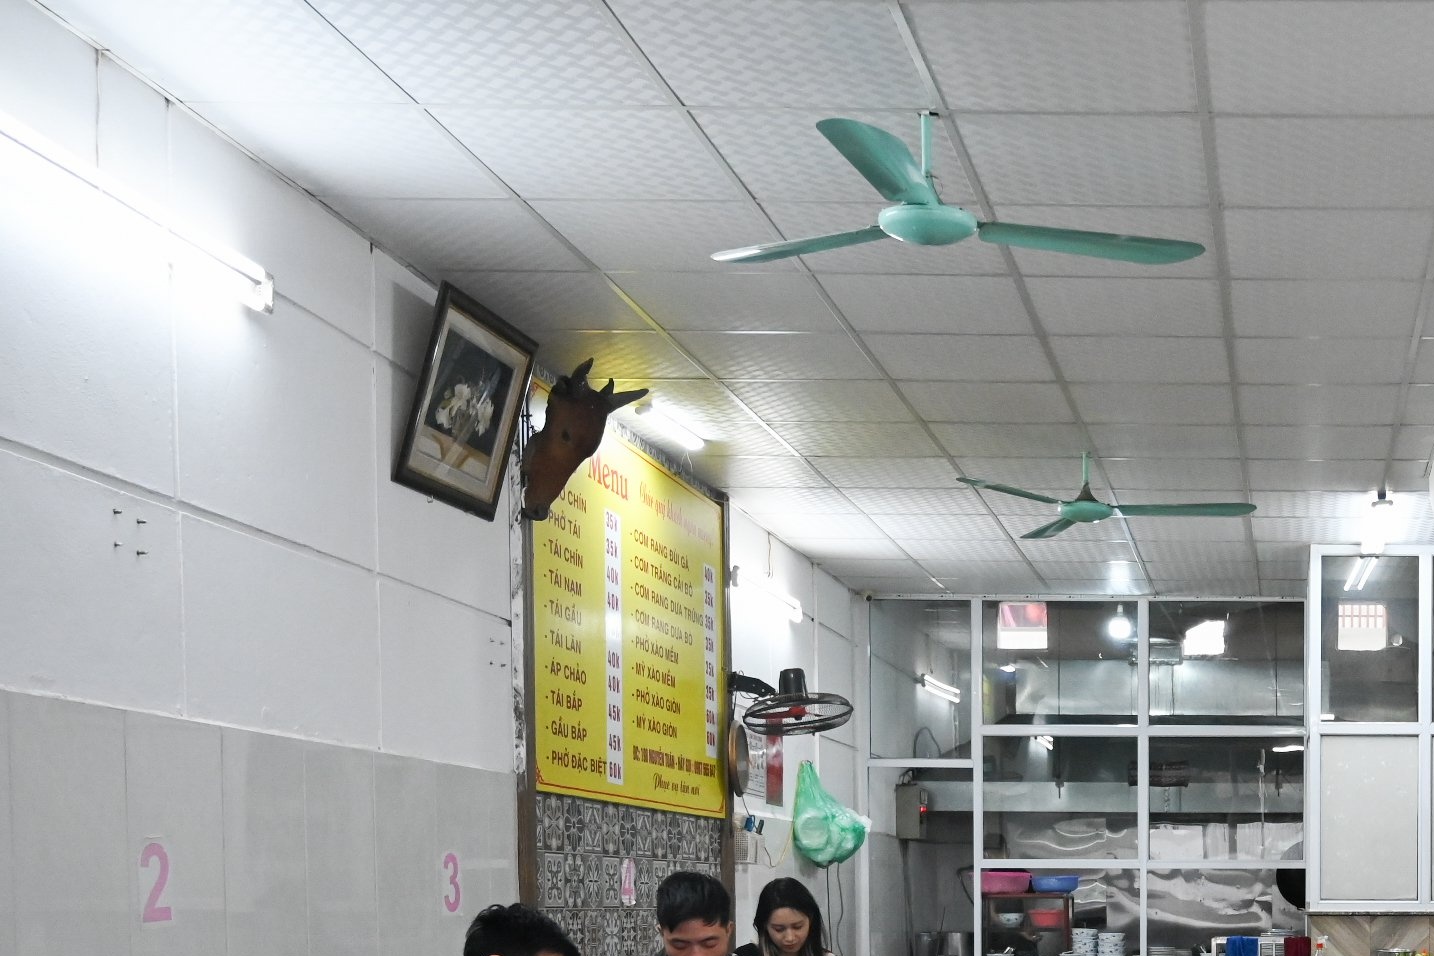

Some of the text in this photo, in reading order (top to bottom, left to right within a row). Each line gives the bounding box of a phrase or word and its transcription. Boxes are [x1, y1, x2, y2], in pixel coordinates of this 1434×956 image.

[588, 452, 628, 500] Menu
[568, 490, 587, 514] CHÍN
[568, 519, 581, 539] TÁI
[548, 539, 583, 568] TÁI CHÍN
[651, 539, 668, 559] RANG
[548, 569, 582, 597] TÁI NẠM
[635, 582, 649, 601] CƠM
[651, 591, 669, 610] RANG
[549, 599, 562, 618] TÁI
[549, 628, 563, 648] TÁI
[652, 617, 669, 636] RANG
[635, 635, 649, 652] PHỞ
[651, 641, 664, 658] XÀO
[550, 657, 587, 685] ÁP CHẢO
[647, 666, 660, 683] XÀO
[661, 669, 676, 688] MỀM
[550, 688, 582, 711] TÁI BẮP
[636, 687, 681, 715] PHỞ XÀO GIÒN
[551, 716, 587, 741] GẦU BẮP
[647, 716, 661, 735] XÀO
[662, 722, 677, 739] GIÒN
[552, 747, 607, 776] PHỞ ĐẶC BIỆT
[140, 842, 173, 923] 2
[443, 853, 461, 913] 3
